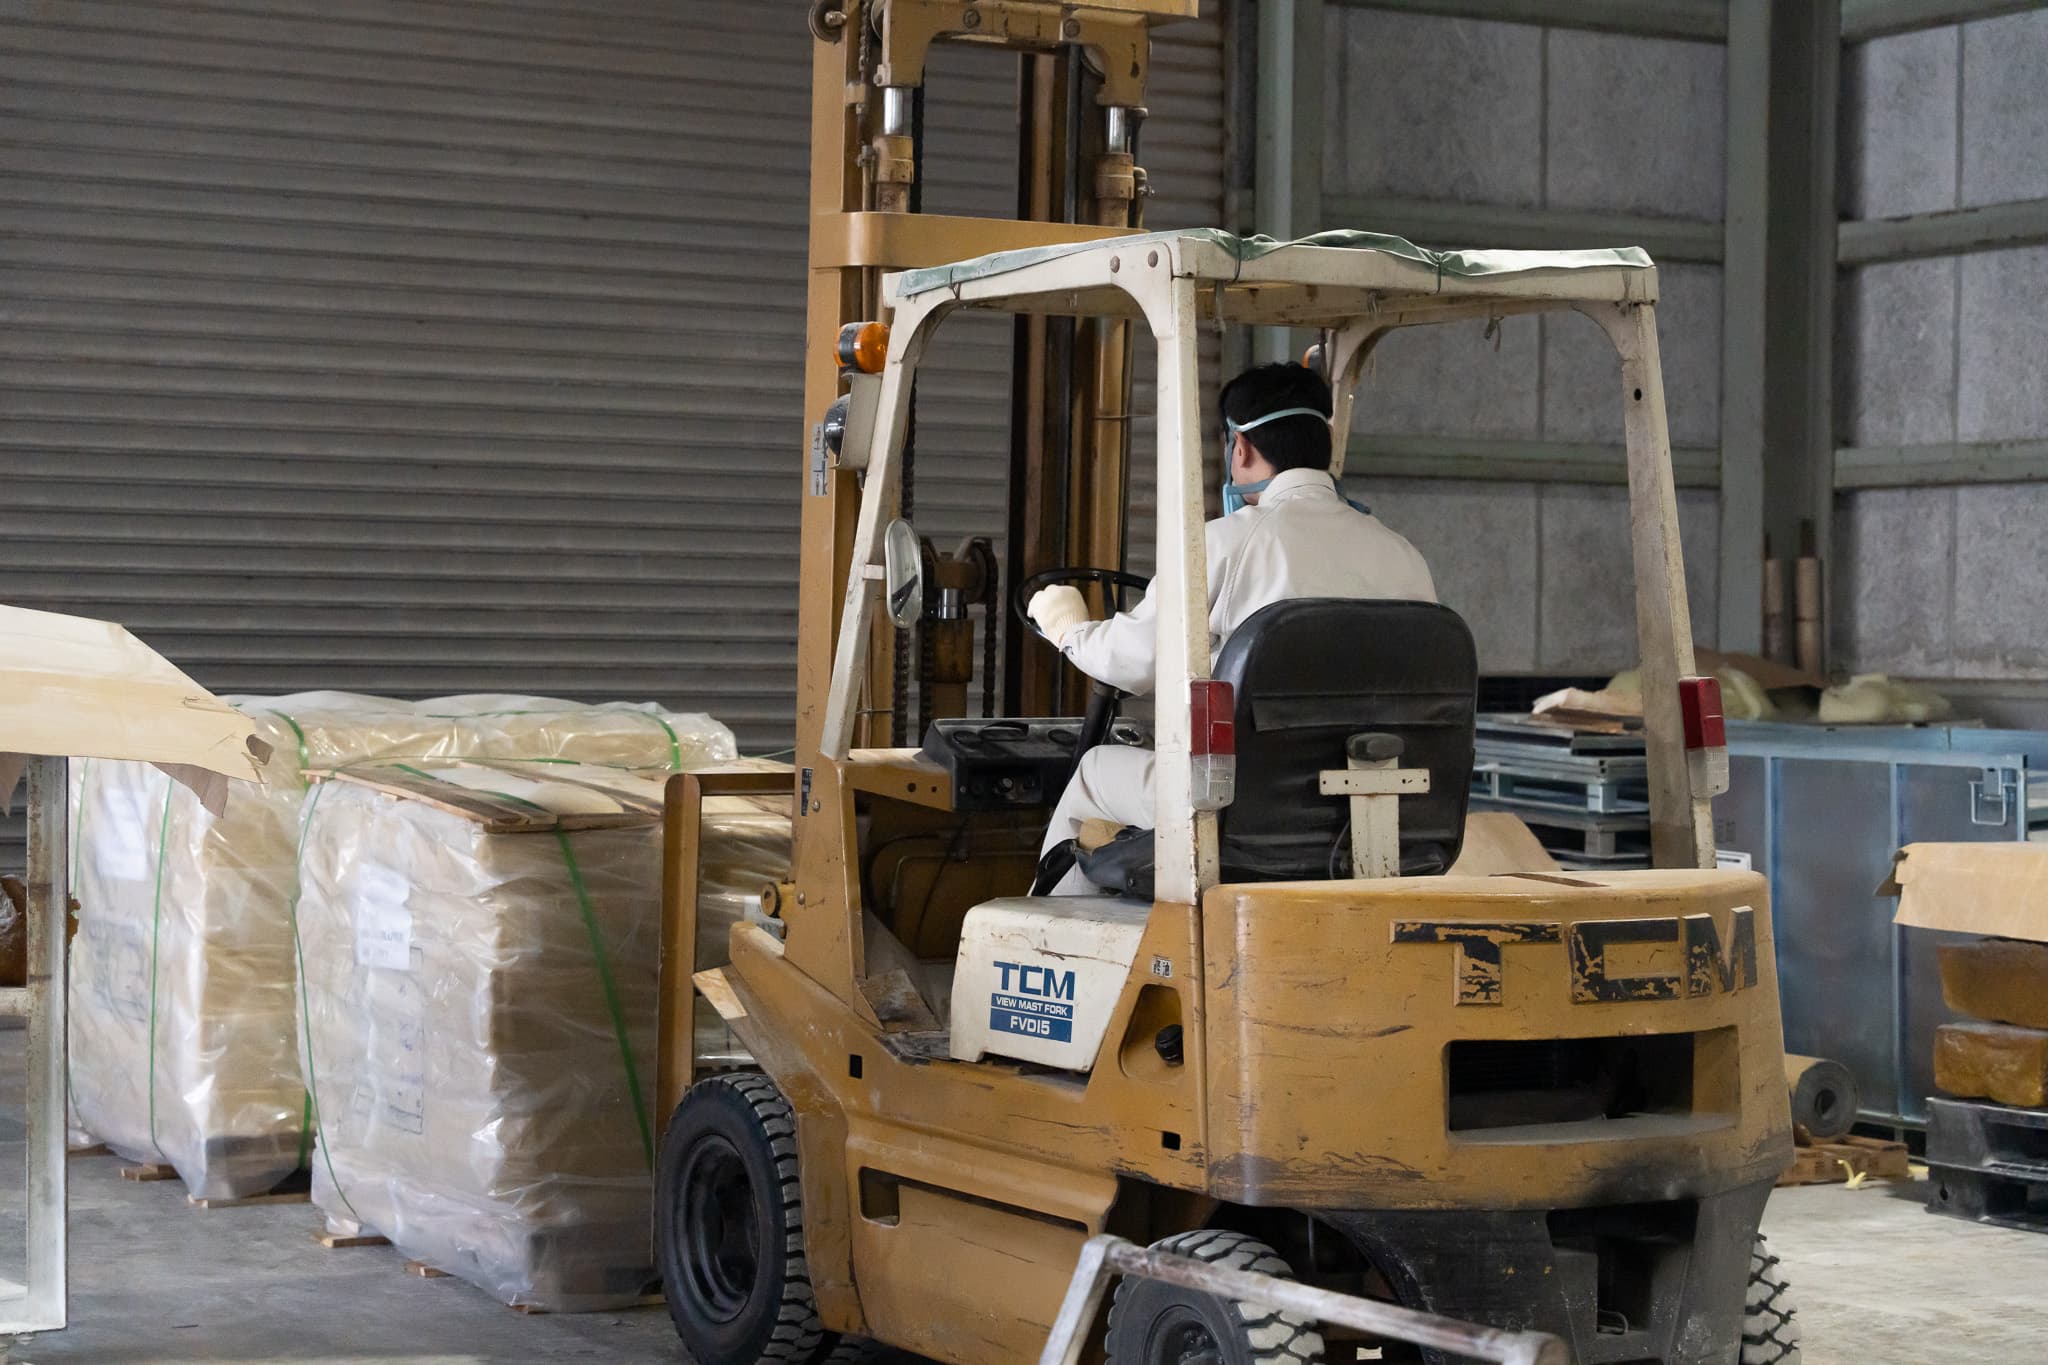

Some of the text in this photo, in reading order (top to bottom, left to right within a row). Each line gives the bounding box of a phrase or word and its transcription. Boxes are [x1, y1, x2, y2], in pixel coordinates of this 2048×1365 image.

[1389, 906, 1758, 1007] TCM
[993, 961, 1075, 1000] TCM
[996, 996, 1067, 1016] VIEW MAST FORK
